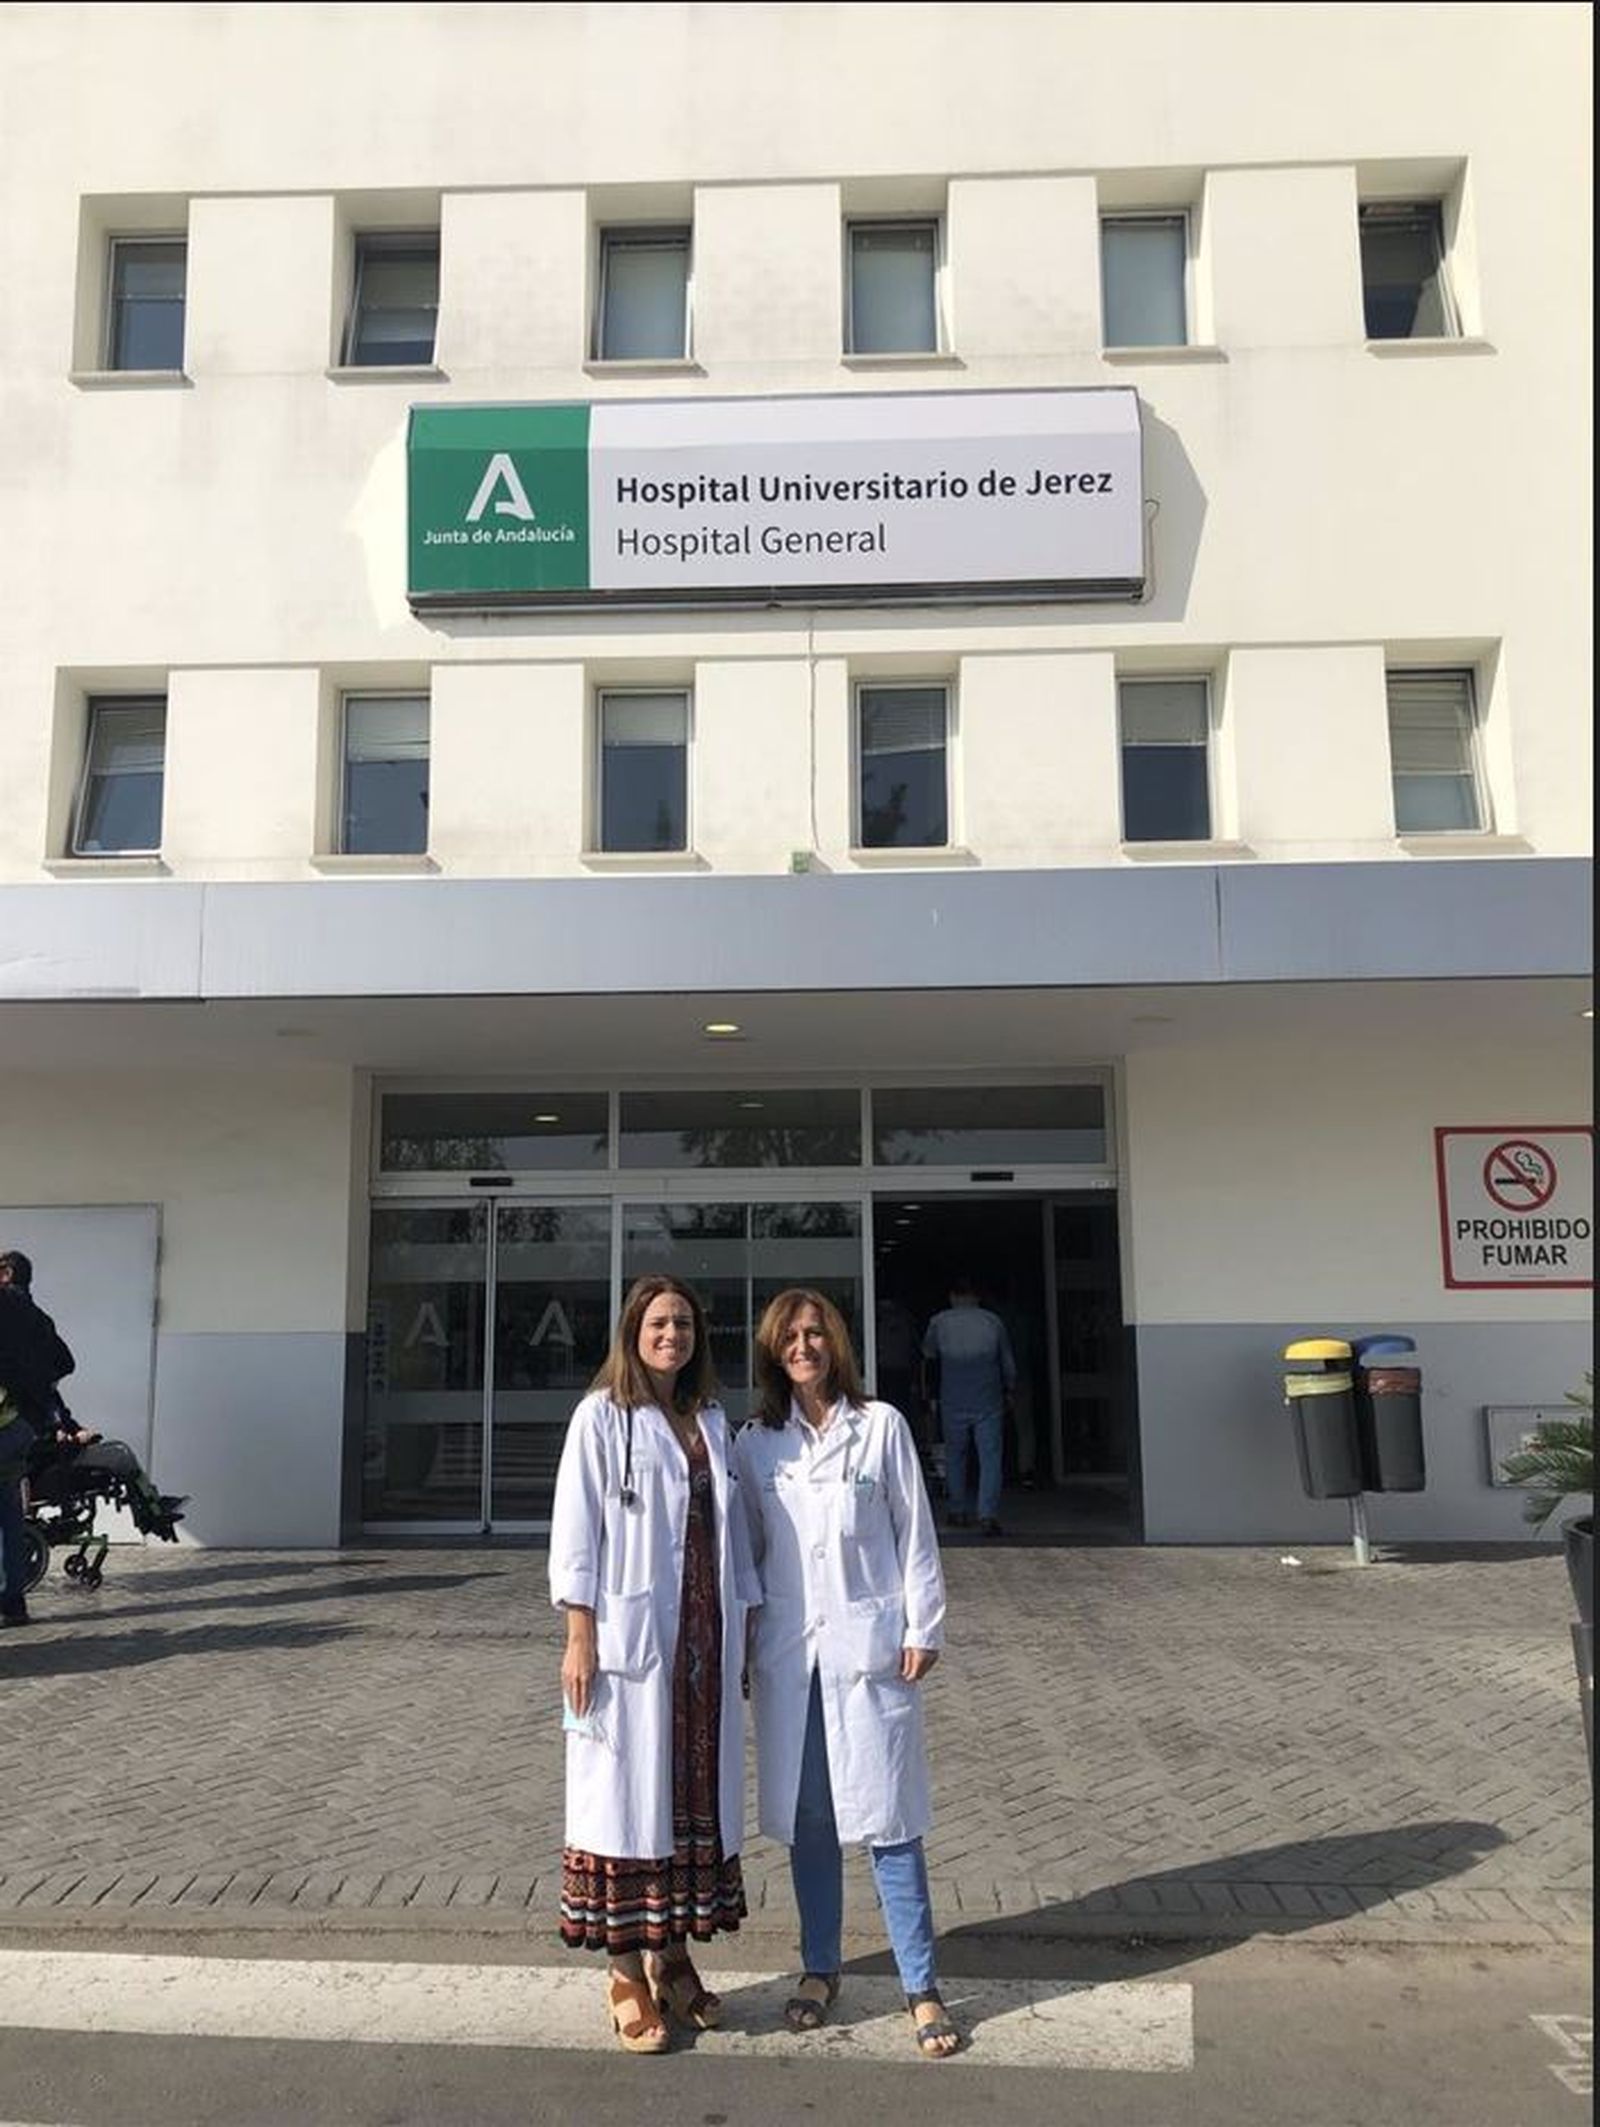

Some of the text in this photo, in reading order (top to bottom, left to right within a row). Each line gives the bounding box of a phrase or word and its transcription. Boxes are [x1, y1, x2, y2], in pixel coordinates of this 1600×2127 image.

[616, 468, 1113, 509] Hospital Universitario de Jerez
[423, 526, 575, 545] Junta de Andalucía
[617, 522, 886, 562] Hospital General
[1456, 1217, 1591, 1241] PROHIBIDO
[1482, 1244, 1568, 1267] FUMAR
